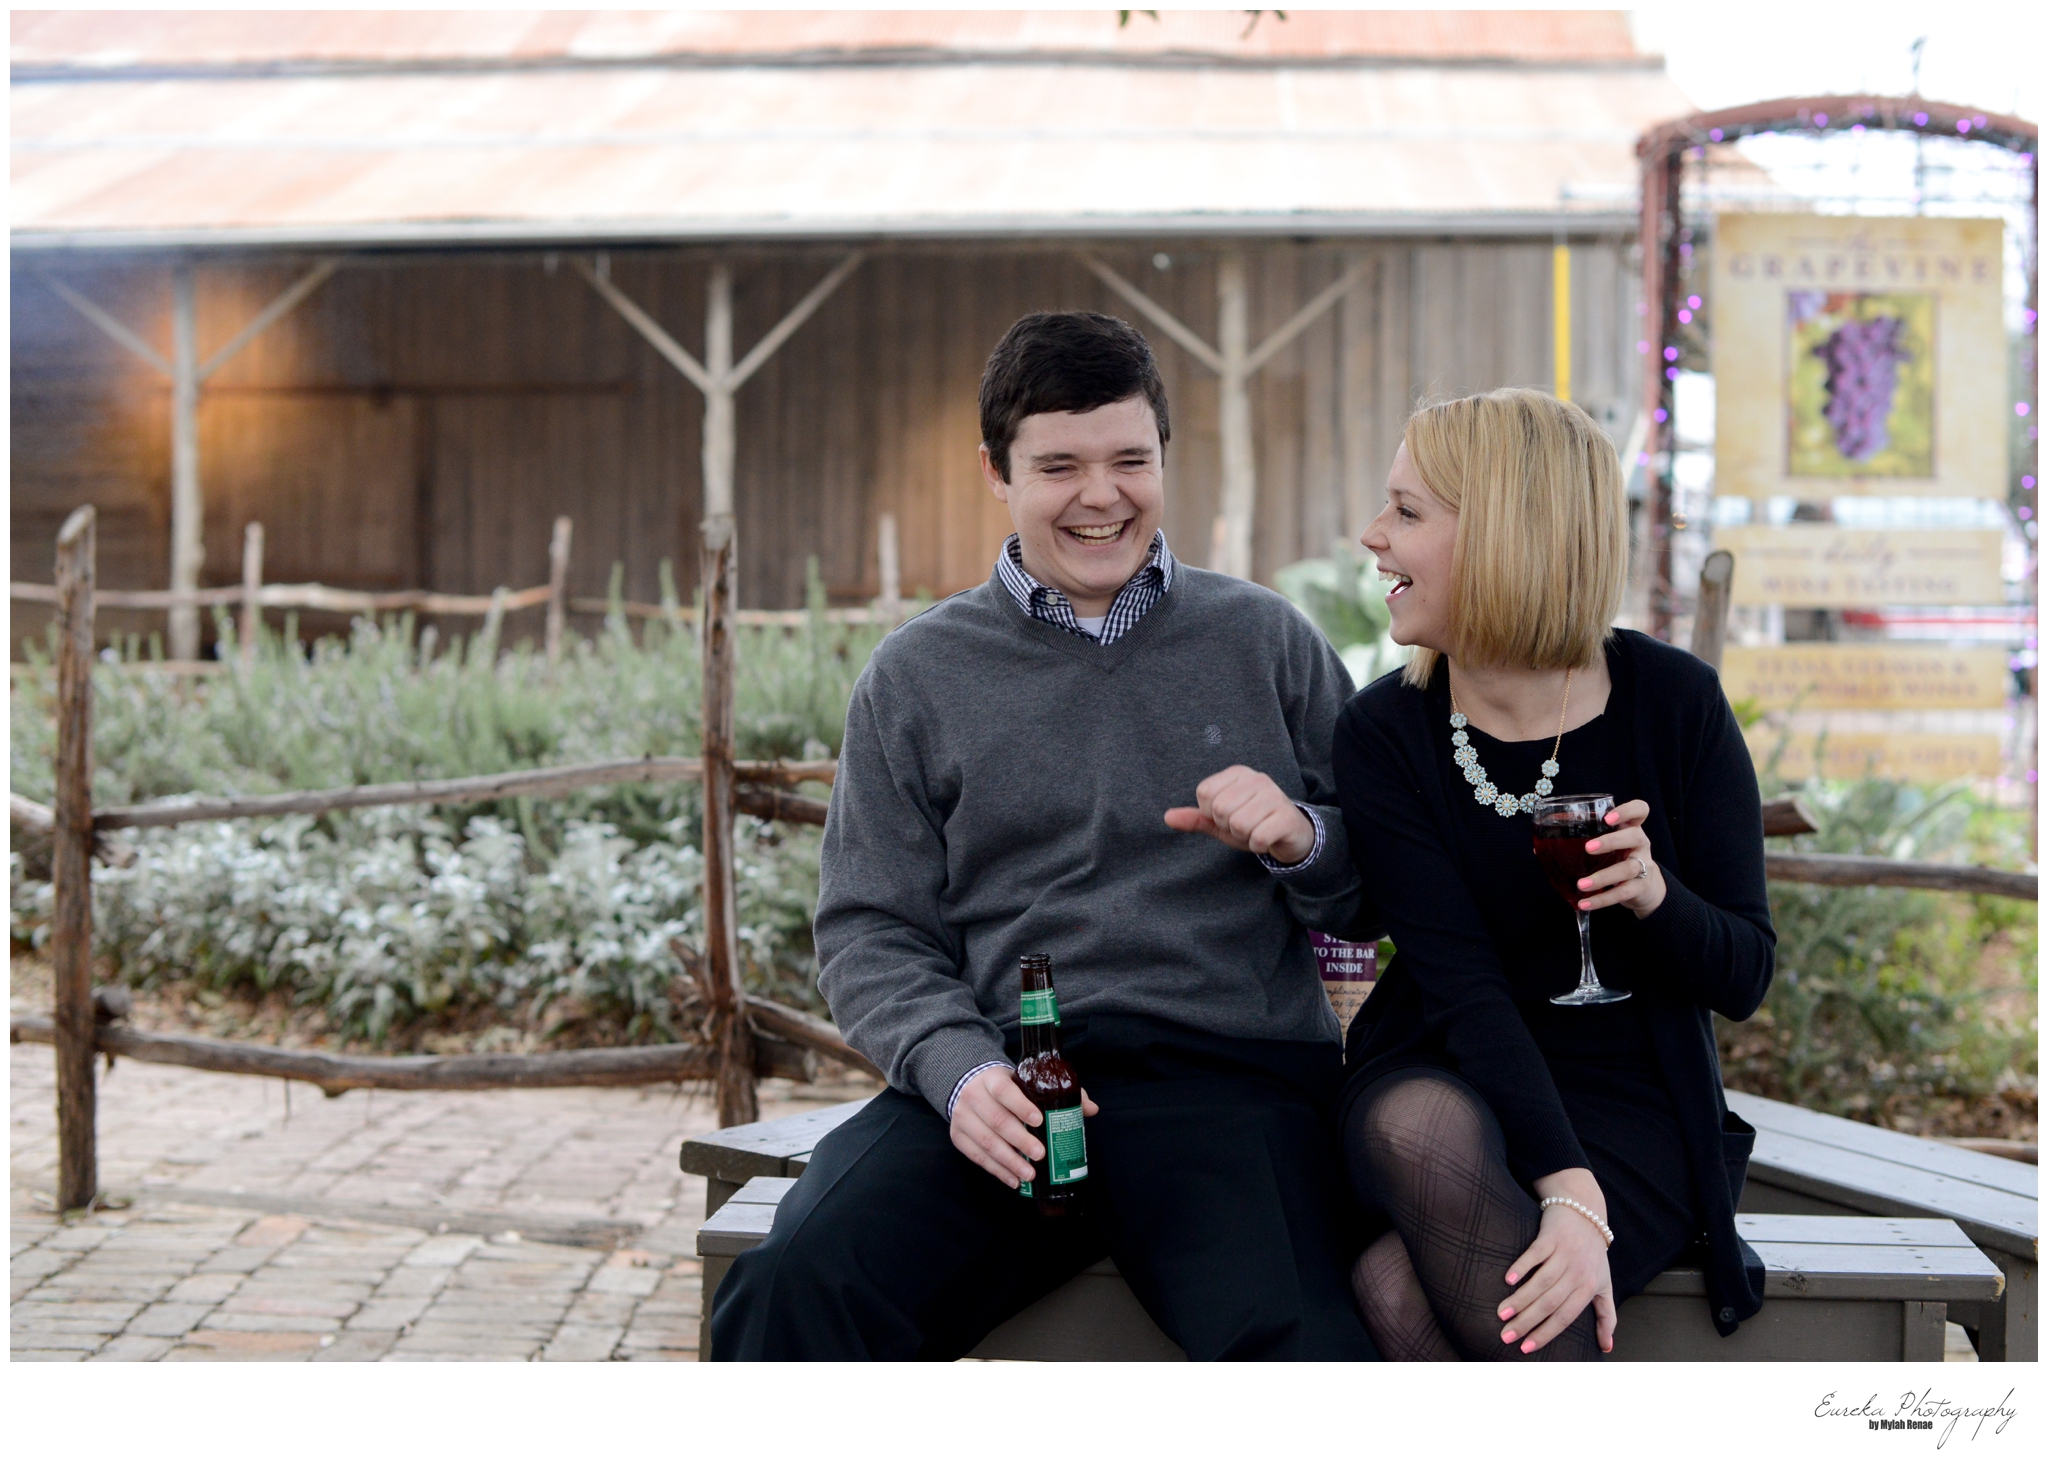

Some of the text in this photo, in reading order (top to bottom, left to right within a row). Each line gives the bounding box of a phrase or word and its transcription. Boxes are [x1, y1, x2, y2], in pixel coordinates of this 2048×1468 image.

[1728, 253, 1992, 282] GRAPEVINE
[1313, 947, 1375, 959] TO THE BAR
[1325, 962, 1363, 974] INSIDE
